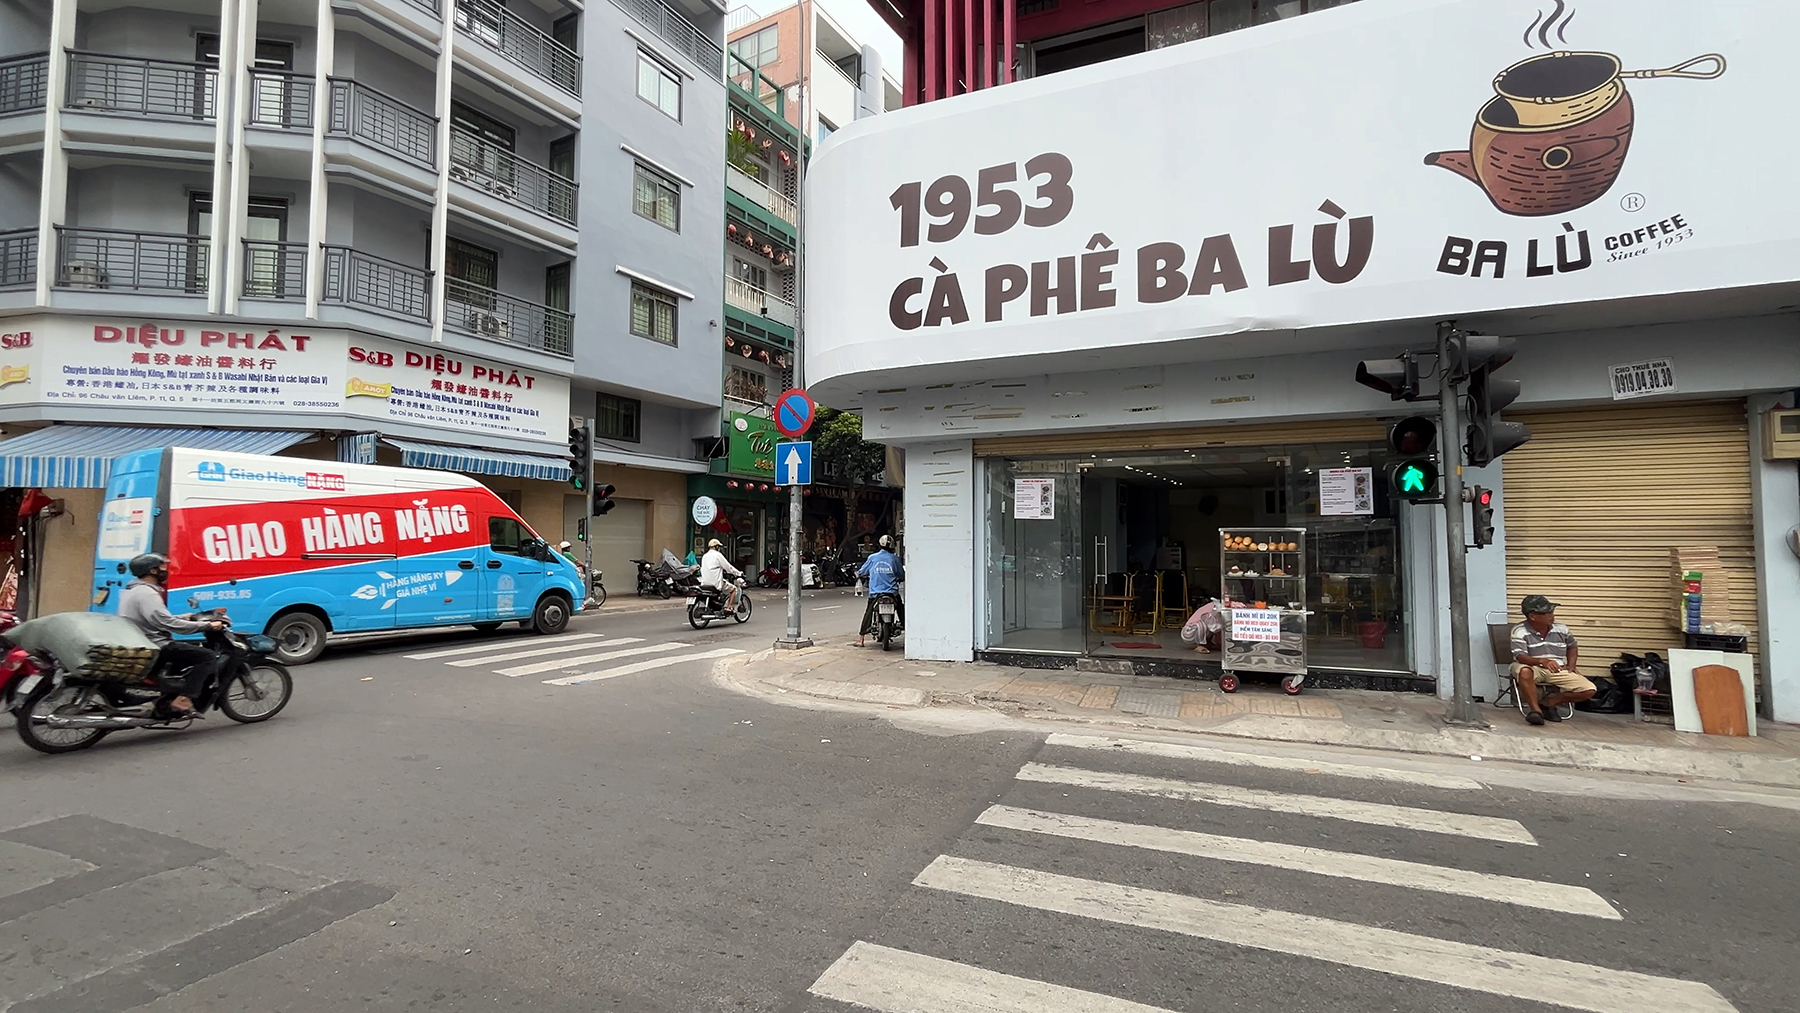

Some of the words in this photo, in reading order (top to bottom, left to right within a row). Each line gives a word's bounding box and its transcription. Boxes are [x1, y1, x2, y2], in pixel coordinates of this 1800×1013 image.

[888, 152, 1074, 248] 1953
[1436, 235, 1508, 279] BA
[1526, 221, 1592, 278] LÙ
[1604, 213, 1688, 252] COFFEE
[1606, 246, 1650, 263] Since
[1655, 228, 1694, 251] 1953
[888, 255, 970, 331] CÀ
[985, 232, 1119, 323] PHÊ
[1137, 233, 1249, 304] BA
[1268, 198, 1375, 287] LÙ
[1, 331, 33, 349] S&B
[93, 323, 185, 349] DIỆU
[200, 328, 312, 352] PHÁT
[206, 371, 211, 380] S
[212, 372, 217, 380] &
[218, 372, 223, 380] B
[224, 372, 247, 381] Wasabi
[348, 346, 394, 367] S&B
[405, 351, 462, 375] DIỆU
[473, 365, 535, 389] PHÁT
[1615, 367, 1673, 393] 0919.04.38.38
[90, 392, 110, 400] Châu
[229, 468, 264, 481] Giao
[266, 471, 306, 488] Hàng
[307, 473, 344, 490] NẶNG
[202, 521, 287, 564] GIAO
[301, 507, 385, 552] HÀNG
[394, 499, 470, 543] NẶNG
